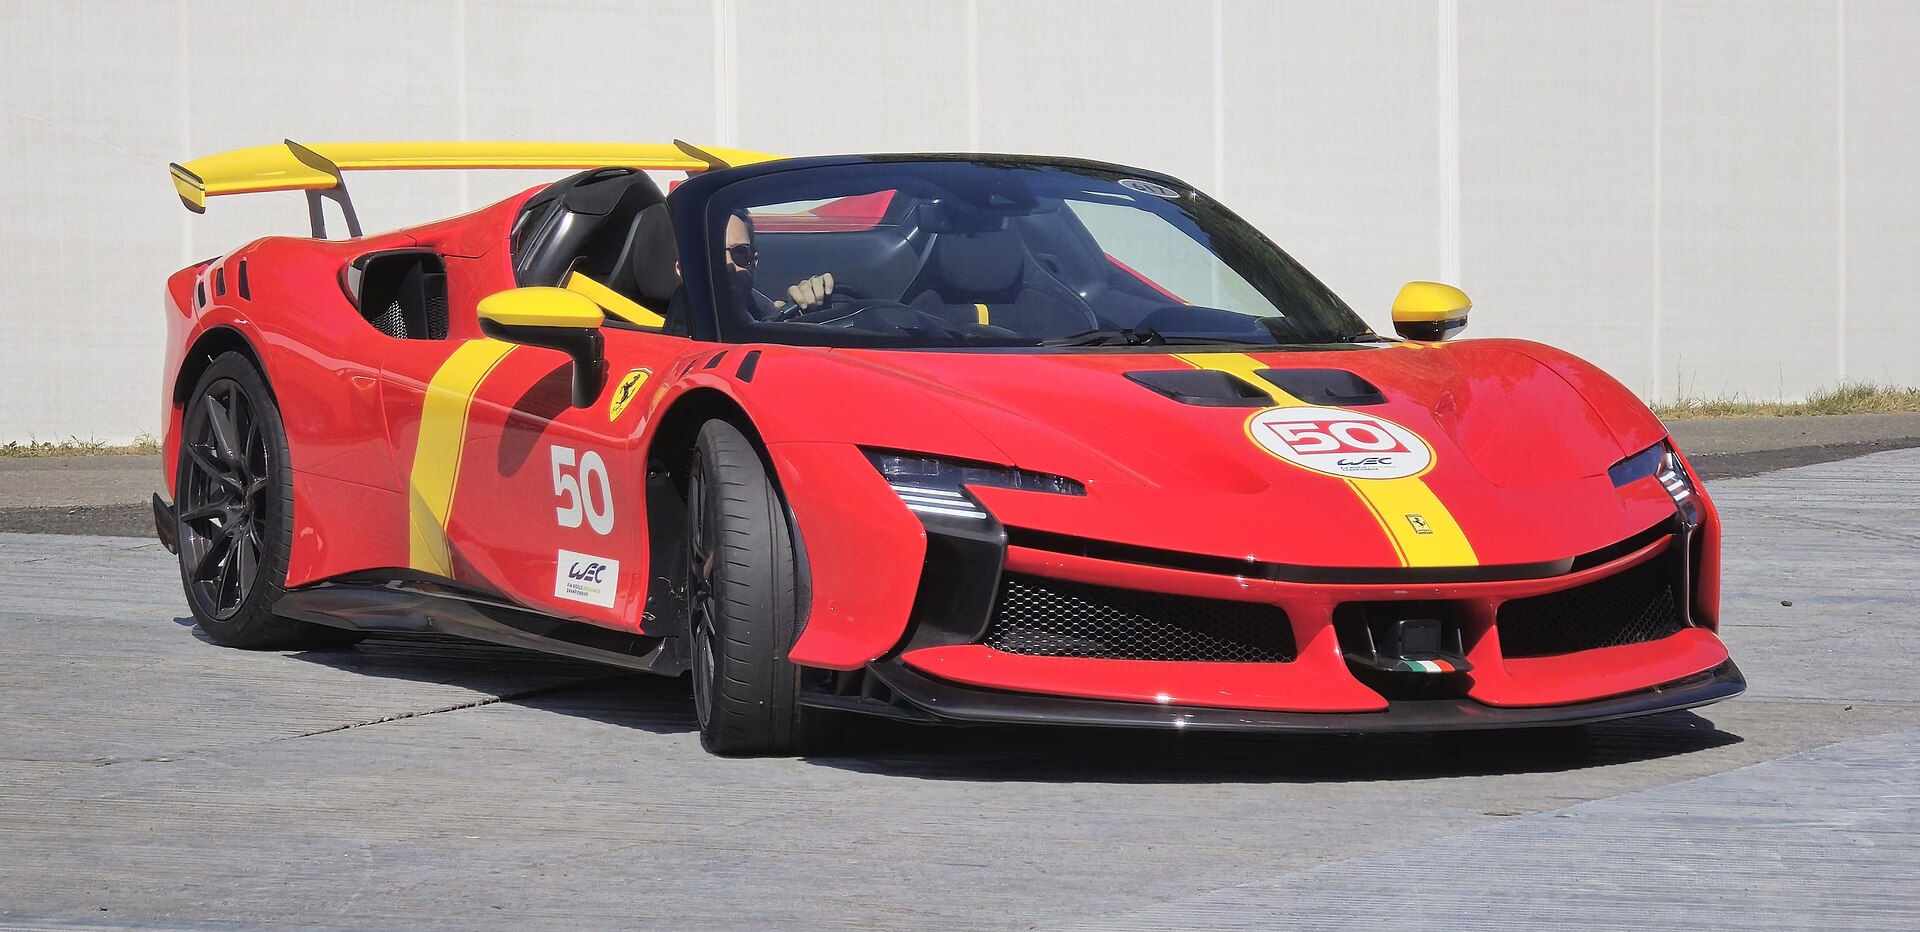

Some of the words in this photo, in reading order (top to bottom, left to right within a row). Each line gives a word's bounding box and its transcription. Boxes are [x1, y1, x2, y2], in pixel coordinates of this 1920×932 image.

[1268, 422, 1397, 451] 50
[1337, 457, 1392, 465] WEC
[551, 444, 615, 535] 50
[568, 562, 607, 584] WEC
